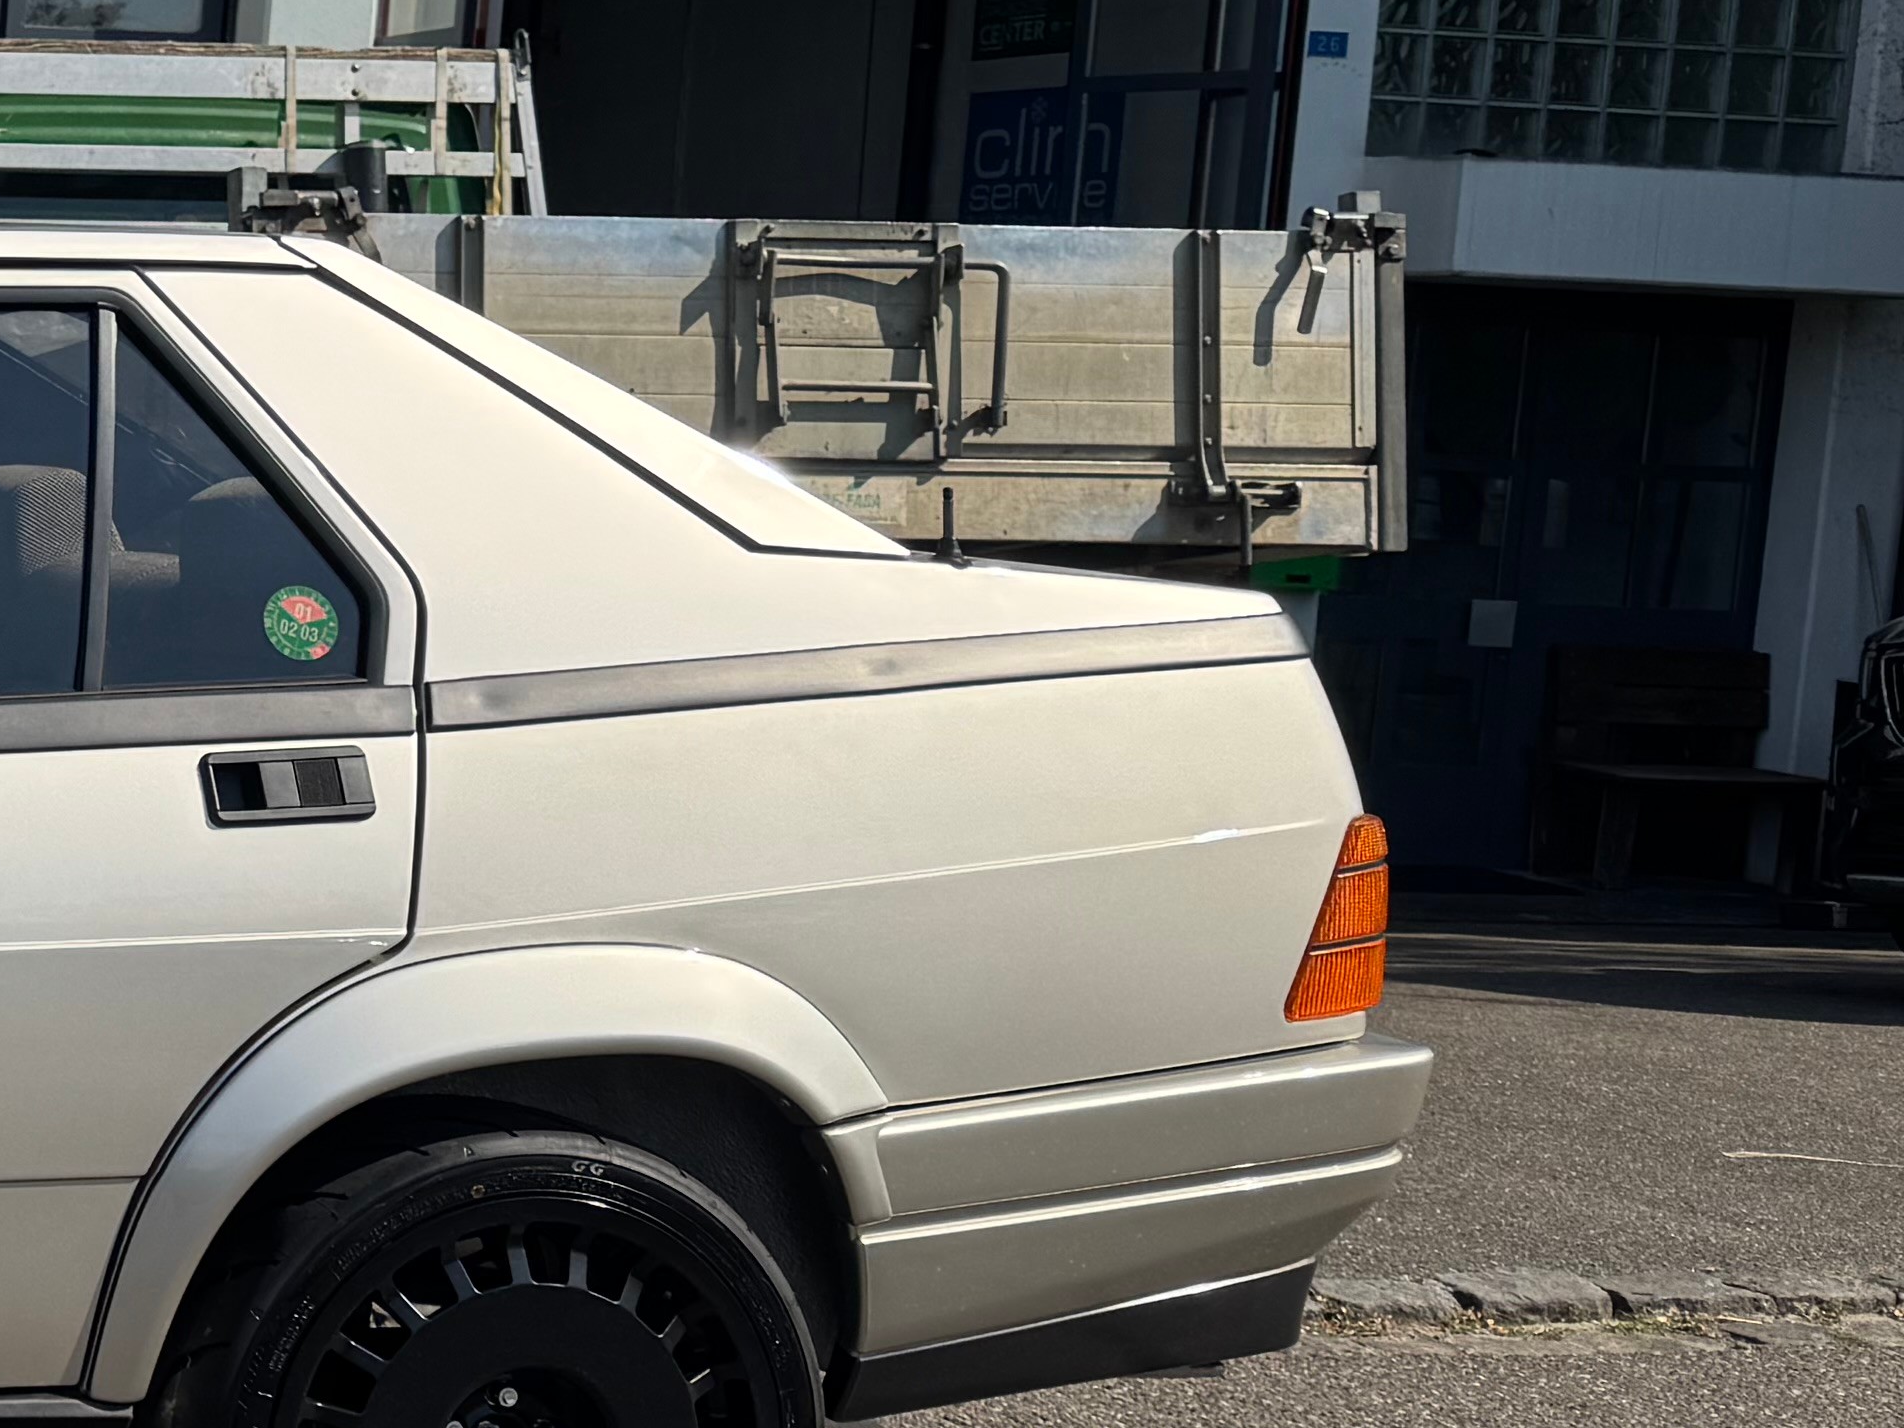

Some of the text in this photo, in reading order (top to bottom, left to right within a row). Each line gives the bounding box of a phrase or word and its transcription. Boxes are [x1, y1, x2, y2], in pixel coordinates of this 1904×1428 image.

[1317, 35, 1341, 52] 26
[295, 602, 313, 623] 01
[280, 619, 318, 642] 02 03
